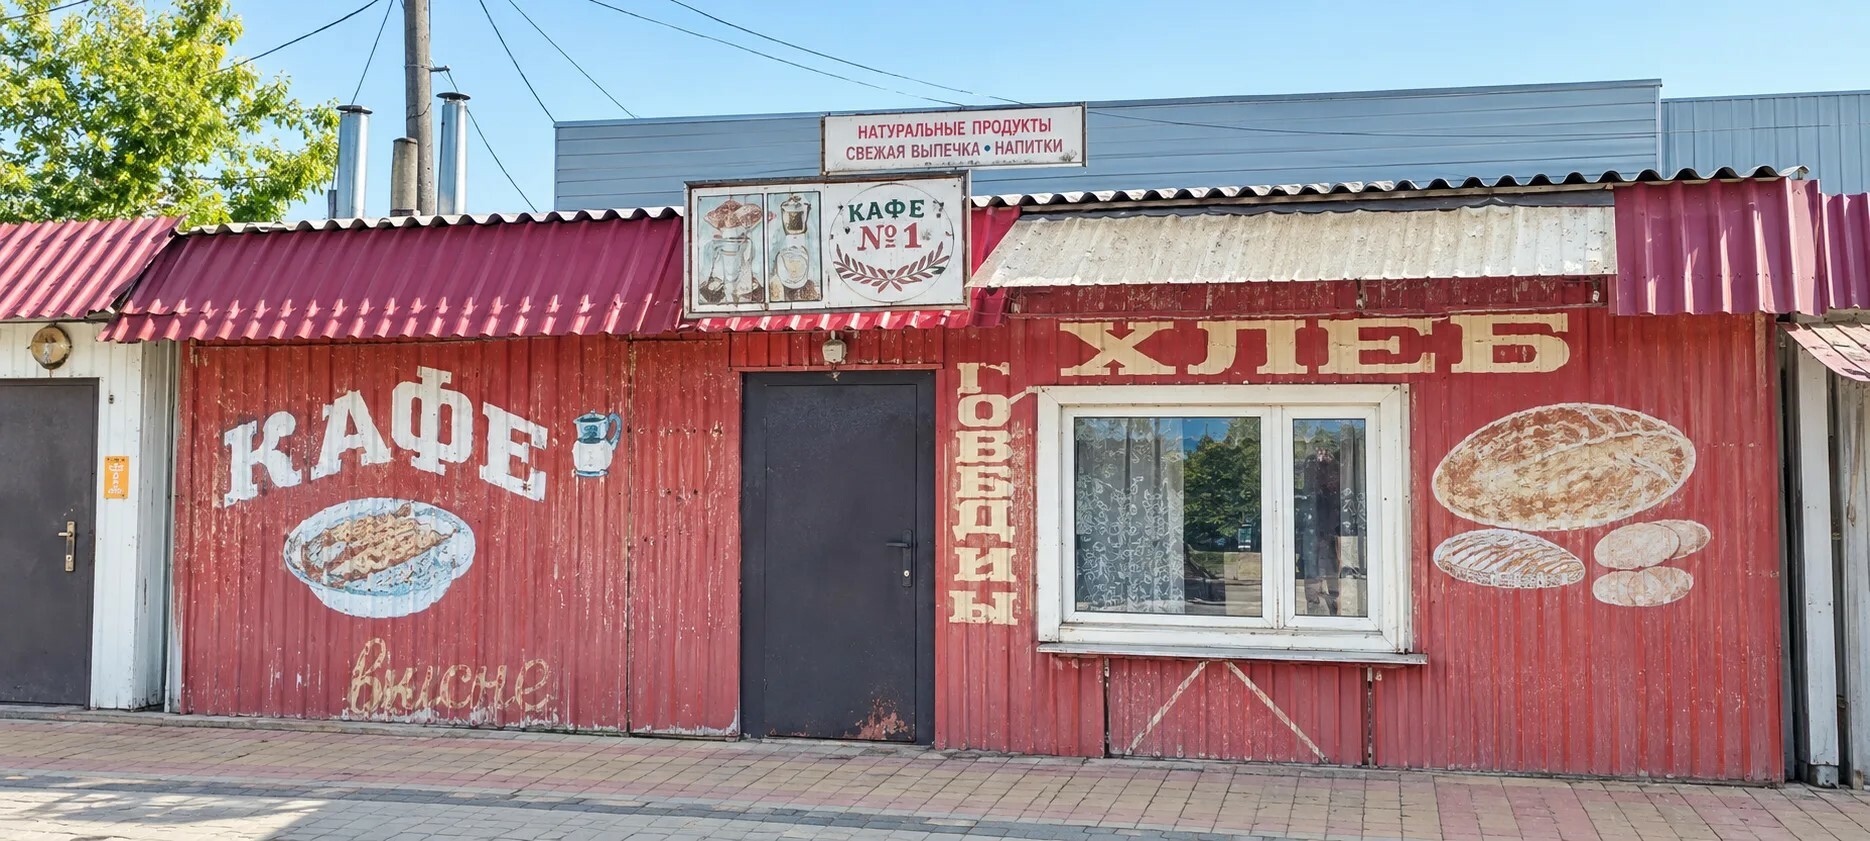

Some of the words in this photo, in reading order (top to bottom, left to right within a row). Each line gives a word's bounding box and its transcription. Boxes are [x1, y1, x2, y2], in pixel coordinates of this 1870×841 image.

[857, 120, 966, 139] НАТУРАЛЬНЫЕ
[972, 117, 1052, 136] ПРОДУКТЫ
[845, 144, 906, 161] СВЕЖАЯ
[911, 141, 981, 158] ВЫПЕЧКА
[994, 138, 1063, 156] НАПИТКИ
[847, 199, 925, 223] КАФЕ
[903, 222, 922, 249] 1
[1059, 312, 1571, 376] ХЛЕБ
[222, 365, 549, 508] КАФЕ
